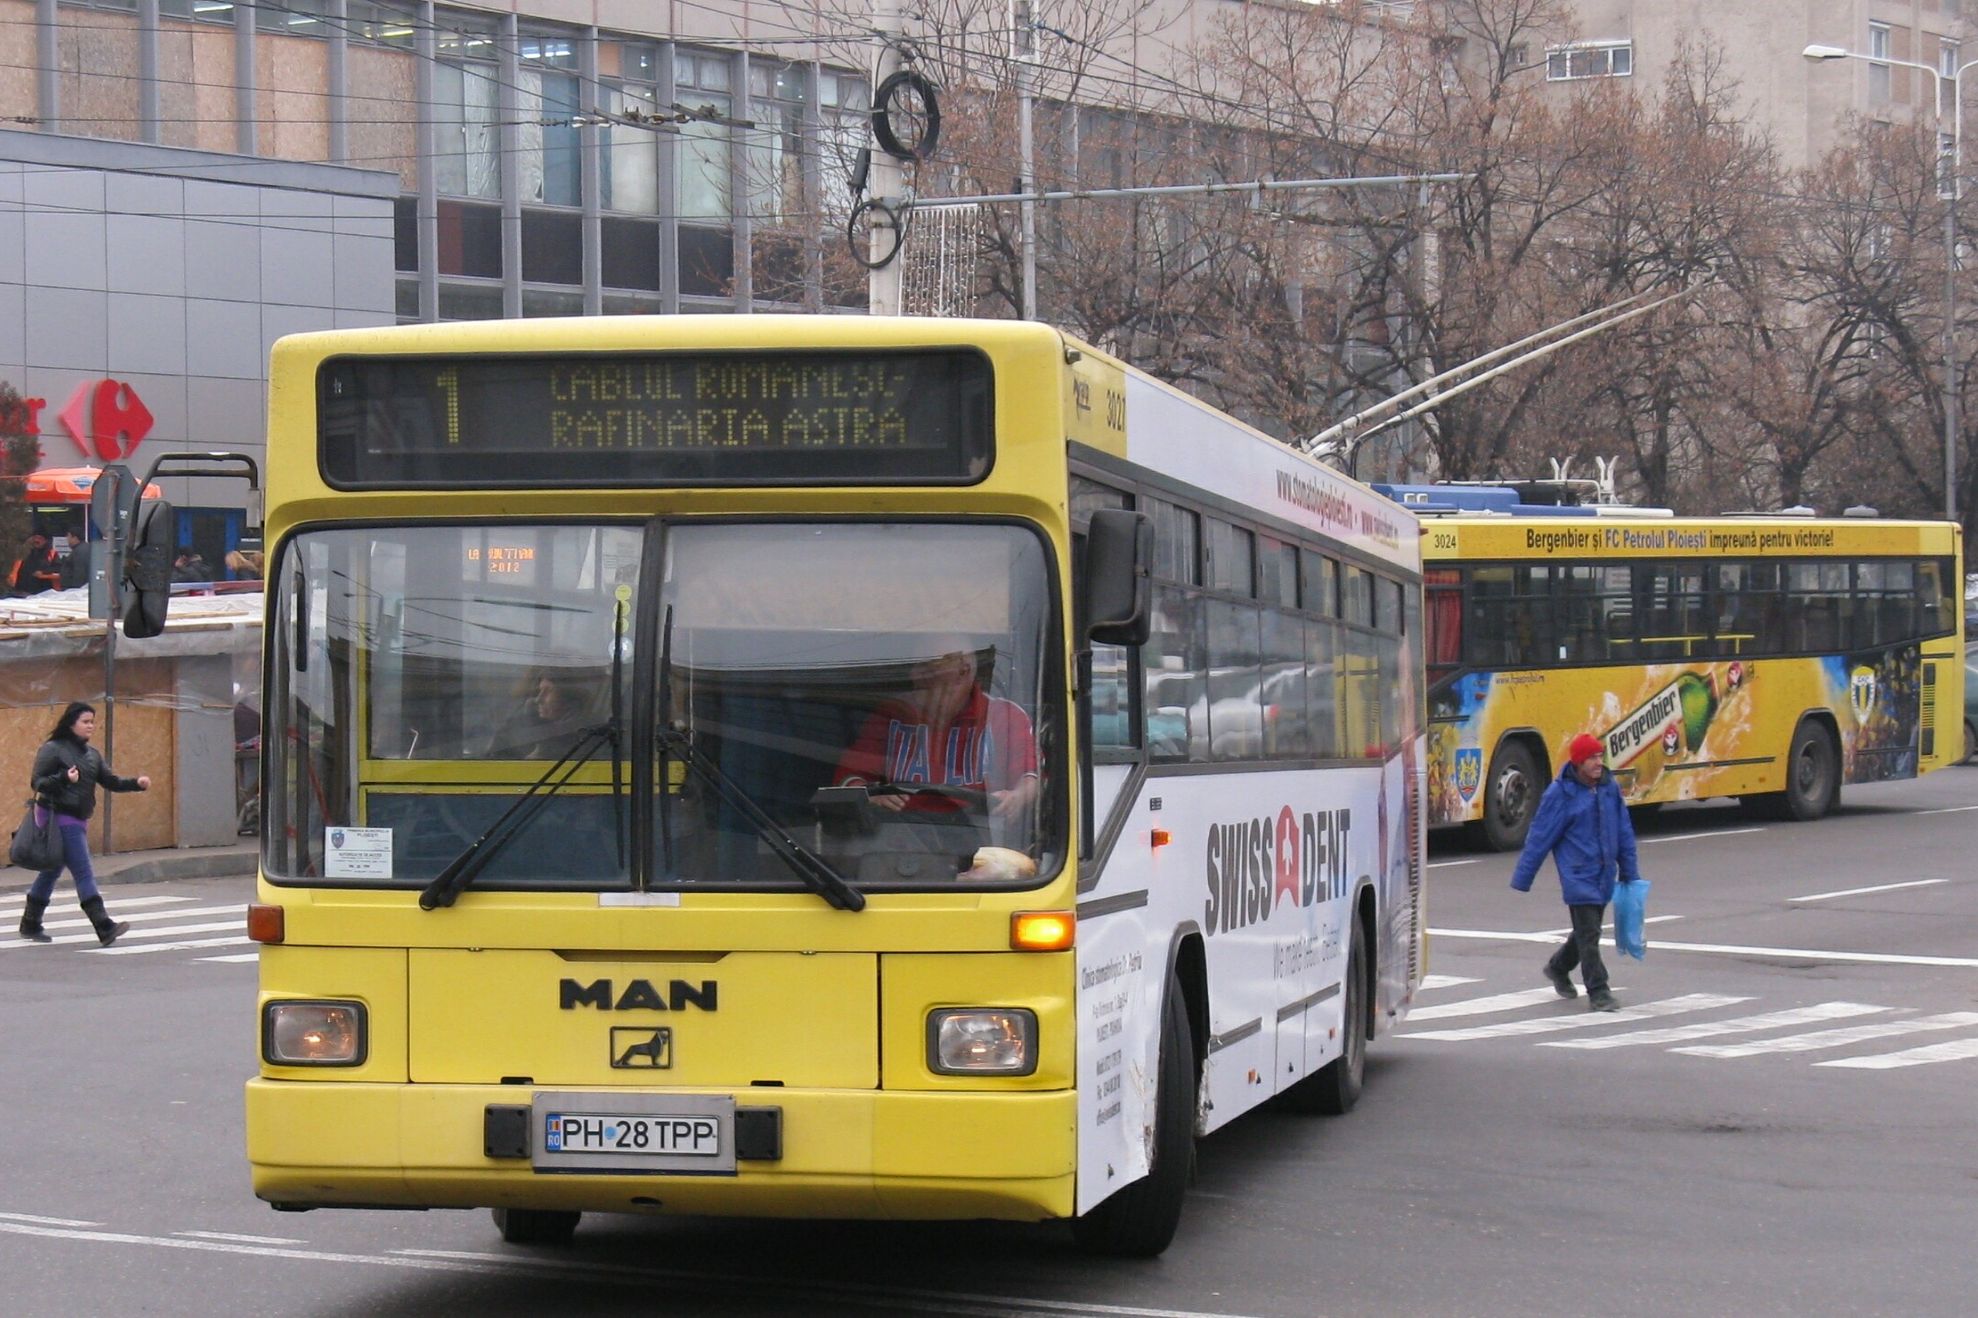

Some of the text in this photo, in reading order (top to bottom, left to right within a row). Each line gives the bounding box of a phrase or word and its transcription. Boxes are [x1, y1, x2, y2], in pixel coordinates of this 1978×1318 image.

[552, 364, 681, 400] CABLUL
[436, 367, 459, 443] 1
[552, 408, 905, 447] RAFINARIA ASTRA
[1434, 534, 1457, 549] 3024
[1526, 528, 1588, 553] Bergenbier
[1605, 528, 1620, 548] FC
[1623, 528, 1665, 549] Petrolul
[1760, 530, 1792, 553] pentru
[1794, 528, 1834, 548] victorie!
[489, 562, 520, 573] 2012
[1609, 690, 1676, 758] Bergenbier
[886, 718, 994, 786] ITALIA
[1205, 808, 1350, 937] SWISS DENT
[559, 978, 718, 1012] MAN
[547, 1134, 560, 1146] RO
[562, 1119, 714, 1150] PH 28 TPP
